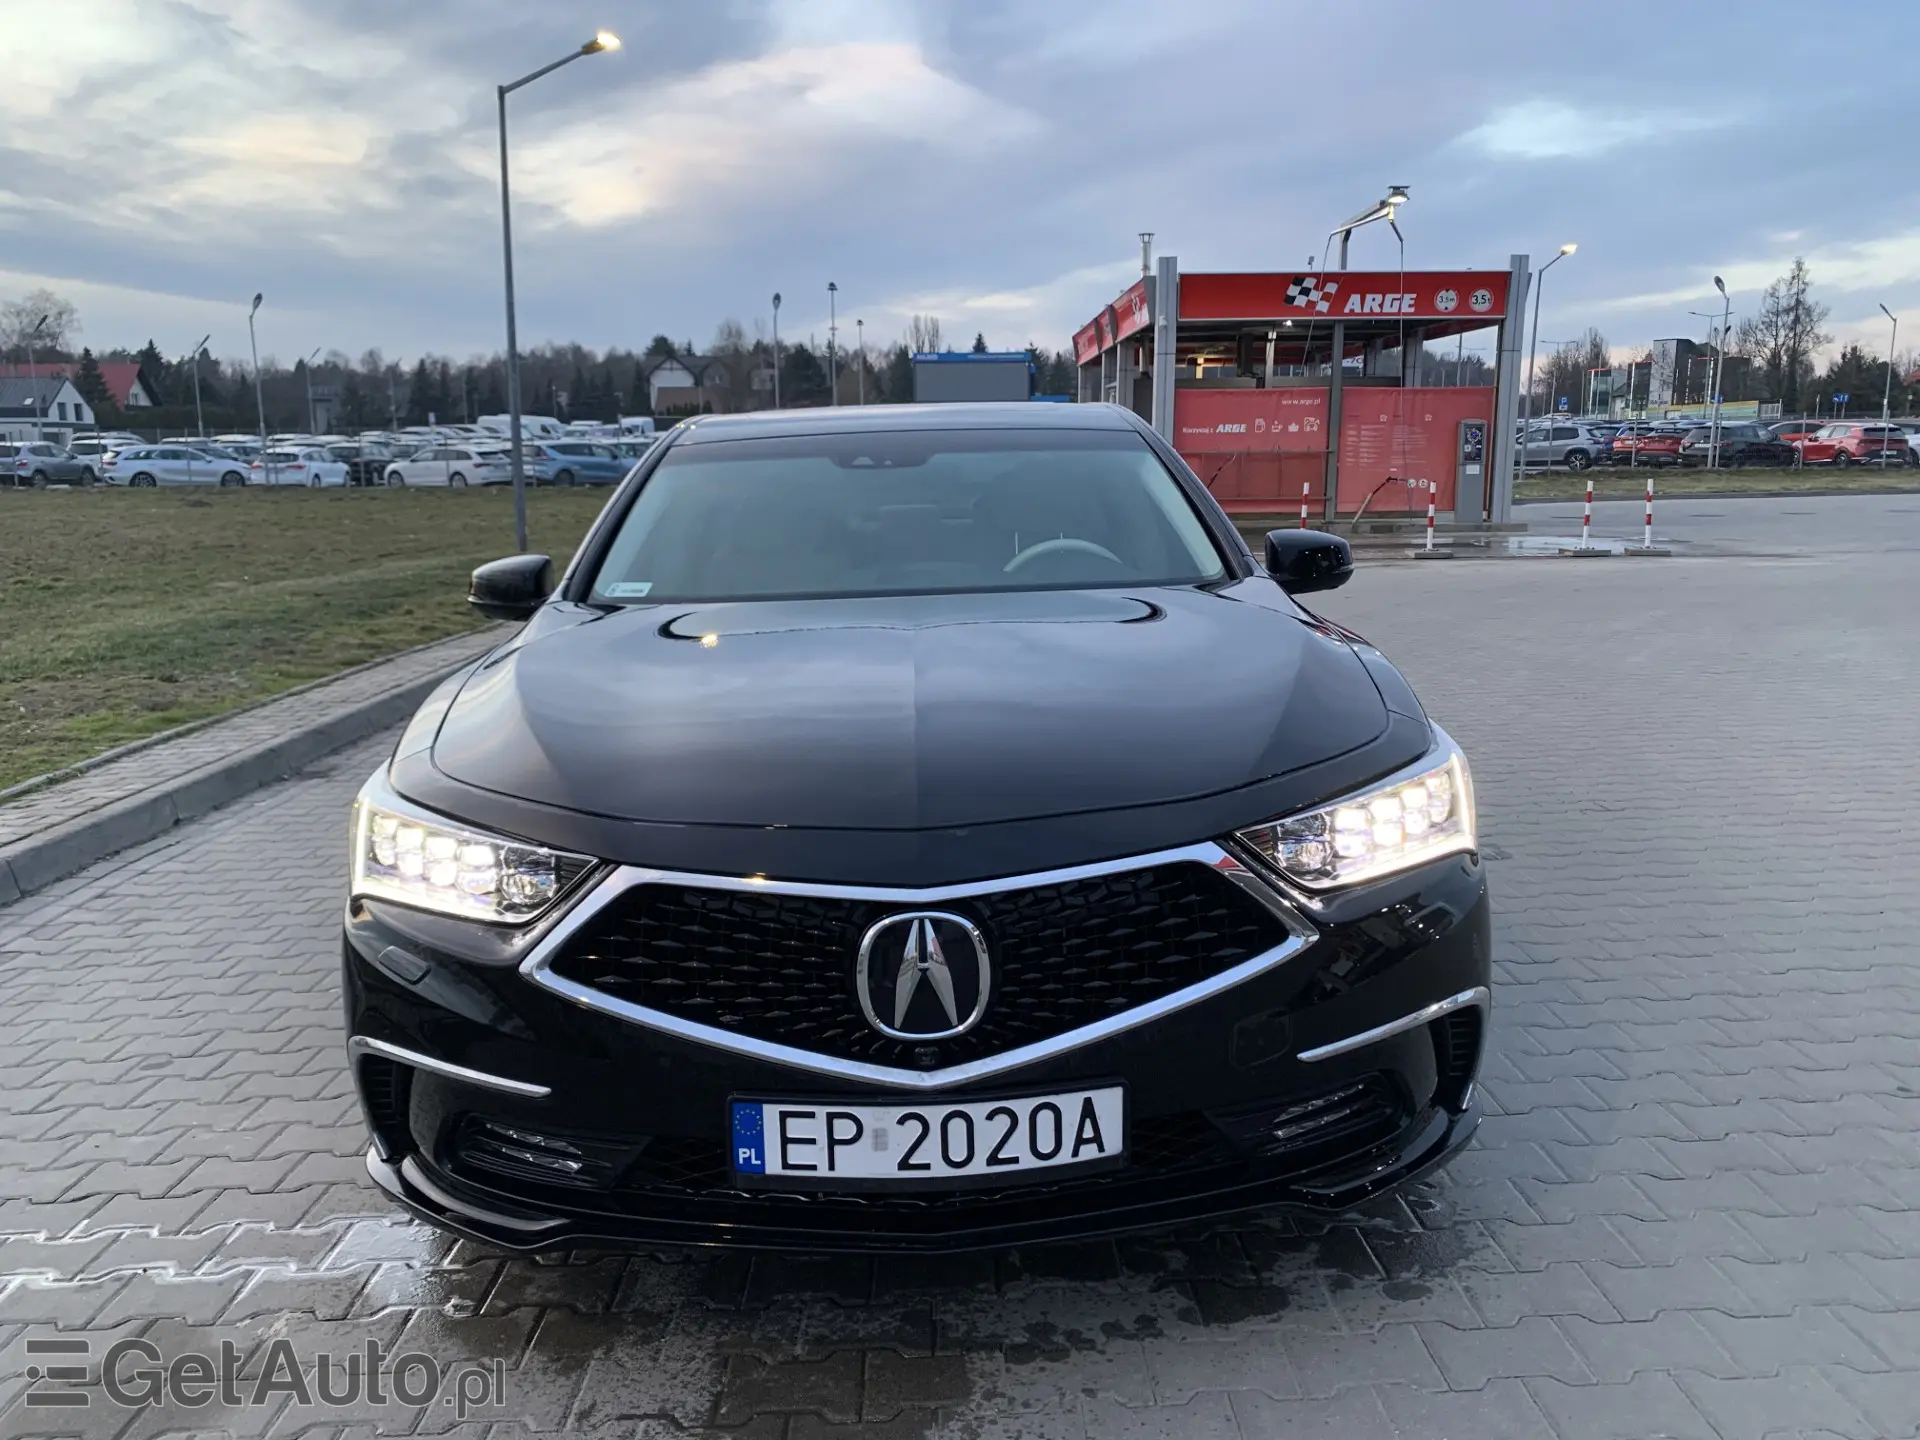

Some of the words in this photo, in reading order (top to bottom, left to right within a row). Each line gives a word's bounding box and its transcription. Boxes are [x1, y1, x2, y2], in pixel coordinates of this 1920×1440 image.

[1343, 293, 1418, 313] ARGE
[1281, 397, 1321, 407] www.arge.pl
[1215, 423, 1248, 433] ARGE
[777, 1109, 865, 1172] EP
[895, 1096, 1106, 1172] 2020A
[738, 1147, 762, 1166] PL
